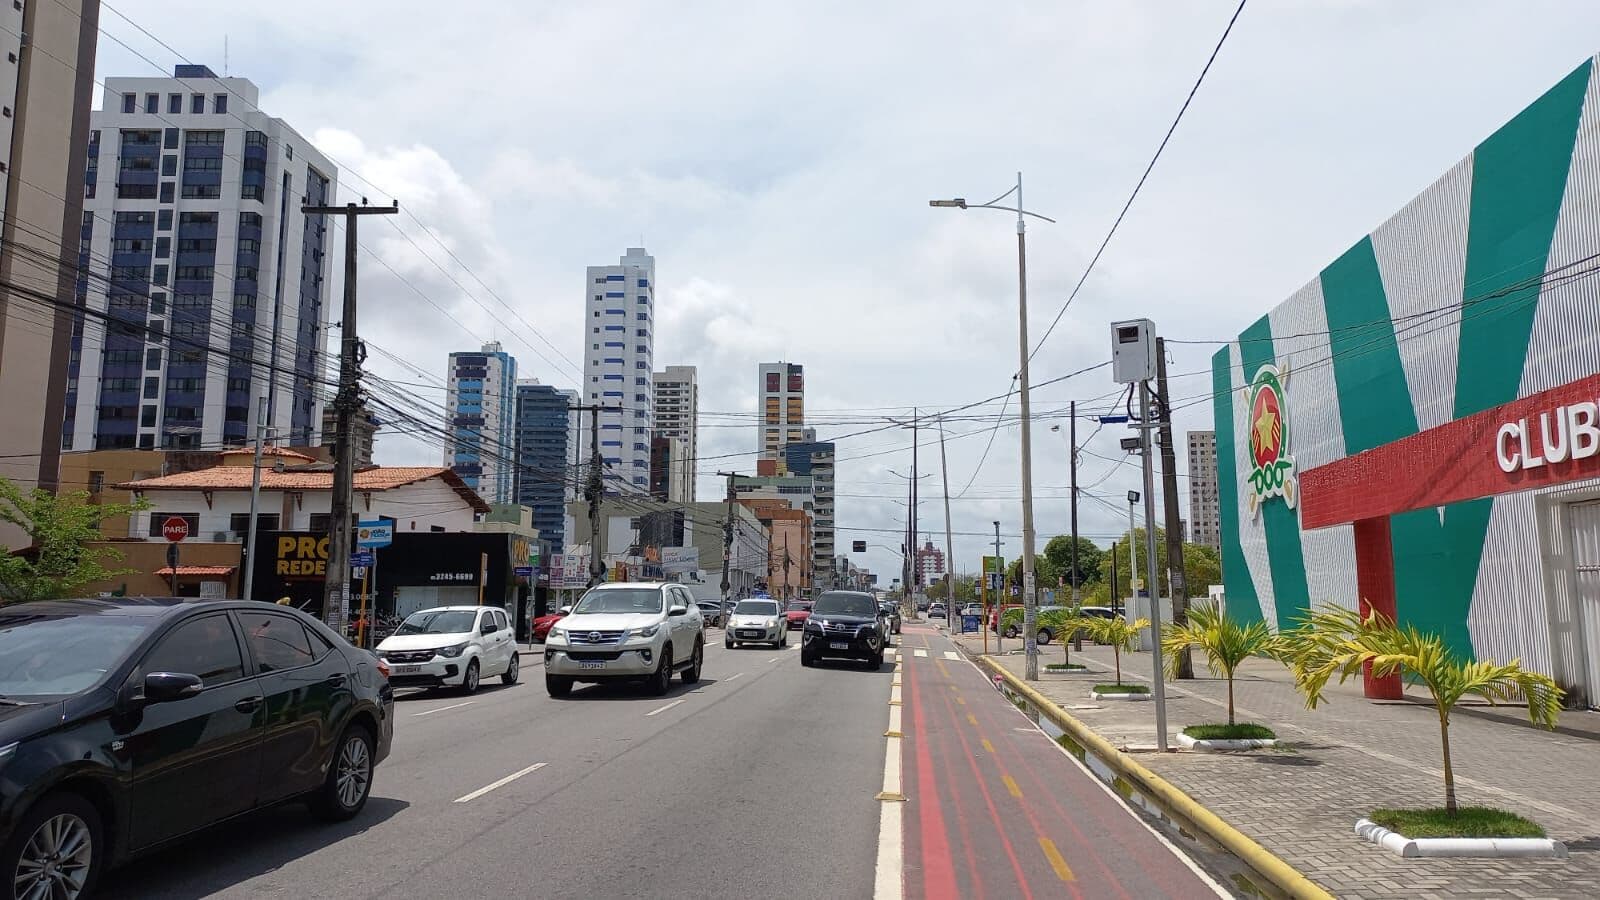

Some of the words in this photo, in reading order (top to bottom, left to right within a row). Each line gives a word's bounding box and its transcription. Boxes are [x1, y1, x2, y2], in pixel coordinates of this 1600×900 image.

[1496, 398, 1600, 473] CLUB
[164, 525, 187, 534] PARE
[276, 560, 326, 576] REDE
